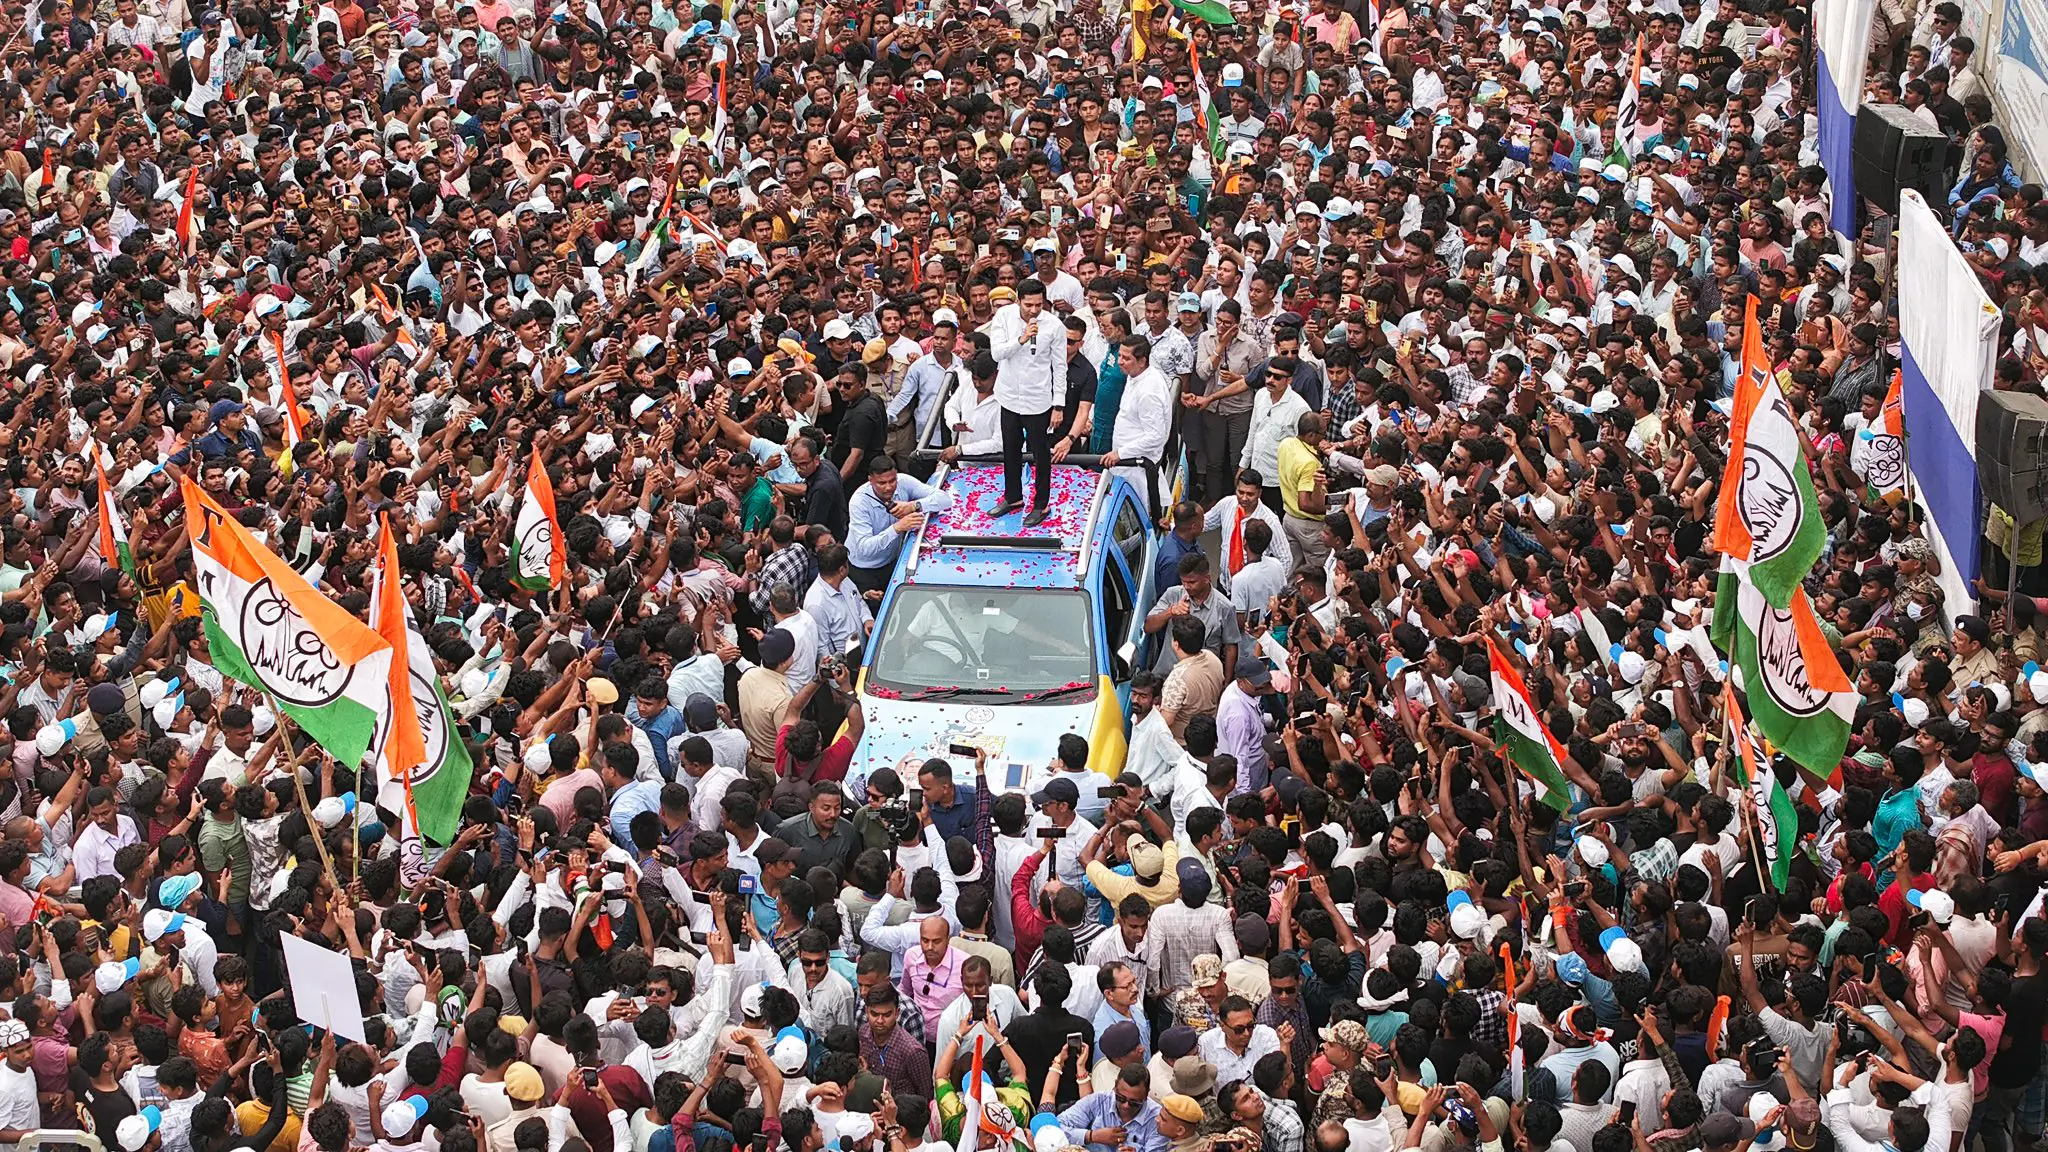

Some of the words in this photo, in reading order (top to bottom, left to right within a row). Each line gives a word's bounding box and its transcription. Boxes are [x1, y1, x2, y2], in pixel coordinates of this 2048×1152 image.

[1709, 56, 1724, 64] YORK
[195, 502, 224, 549] T
[1506, 692, 1529, 727] M
